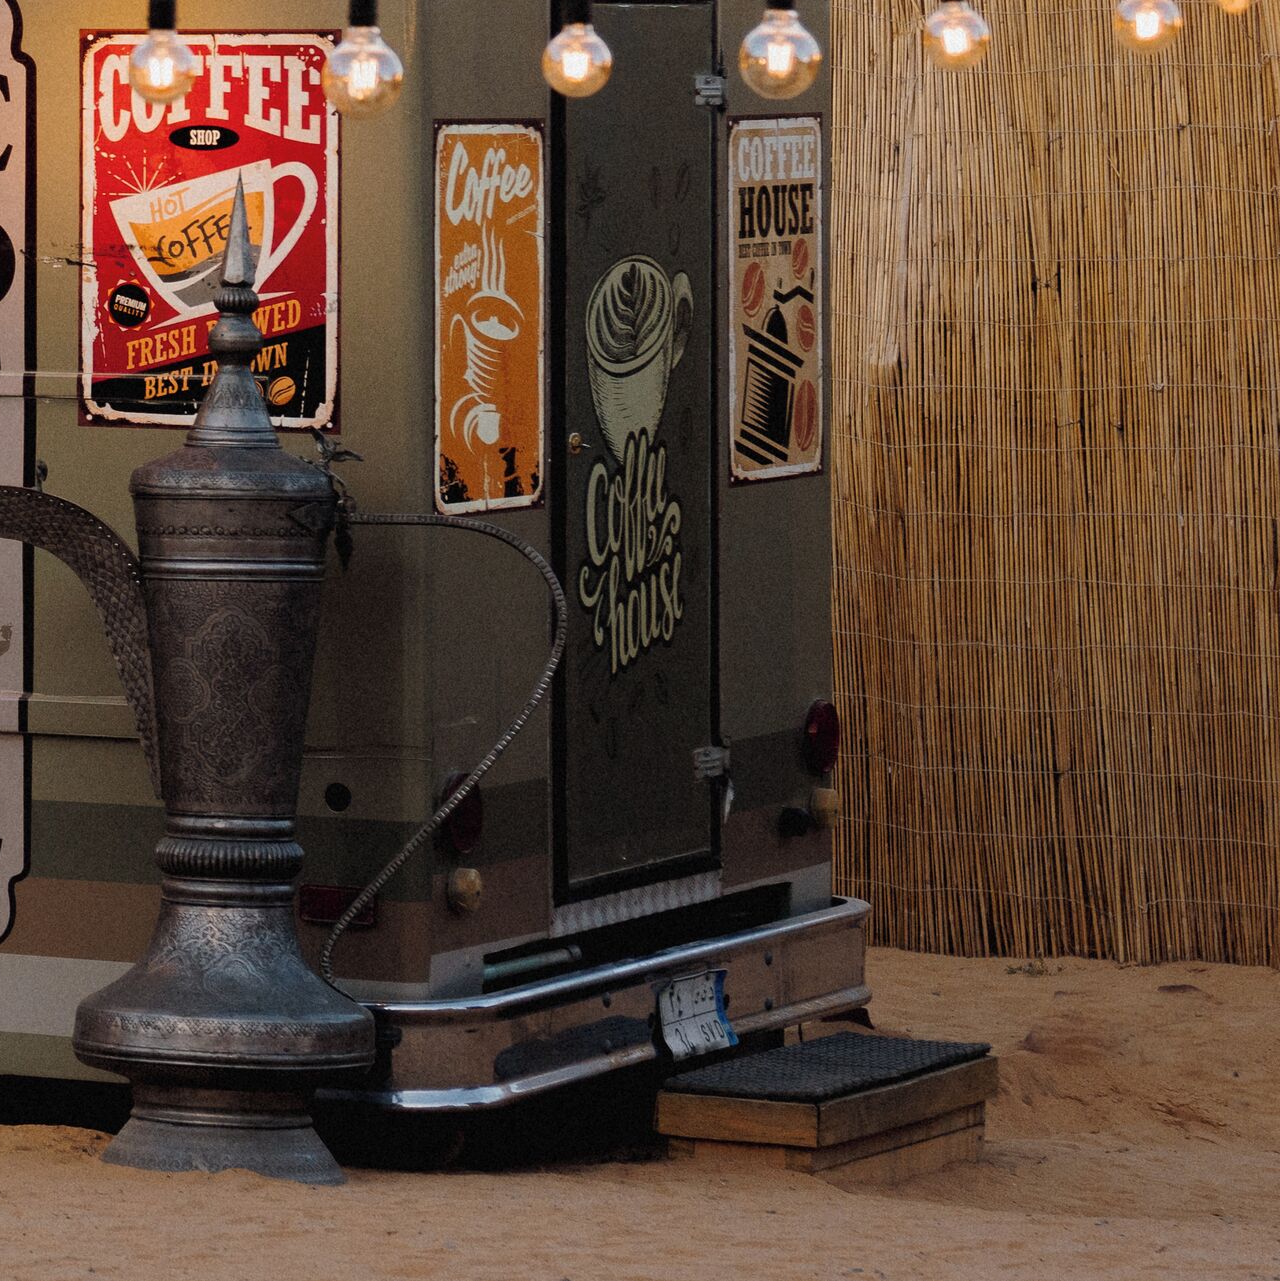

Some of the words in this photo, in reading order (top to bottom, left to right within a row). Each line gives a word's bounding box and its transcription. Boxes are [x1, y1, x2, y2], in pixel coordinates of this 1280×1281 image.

[190, 129, 221, 146] SHOP
[738, 135, 815, 181] COFFEE
[149, 187, 190, 223] HOT
[444, 141, 533, 226] Coffee
[738, 183, 814, 239] HOUSE
[113, 303, 145, 318] QUALITY
[114, 294, 147, 312] PREMIUM
[126, 325, 197, 369] FRESH
[144, 366, 193, 400] BEST
[586, 432, 669, 582] Coffee
[580, 552, 683, 673] house
